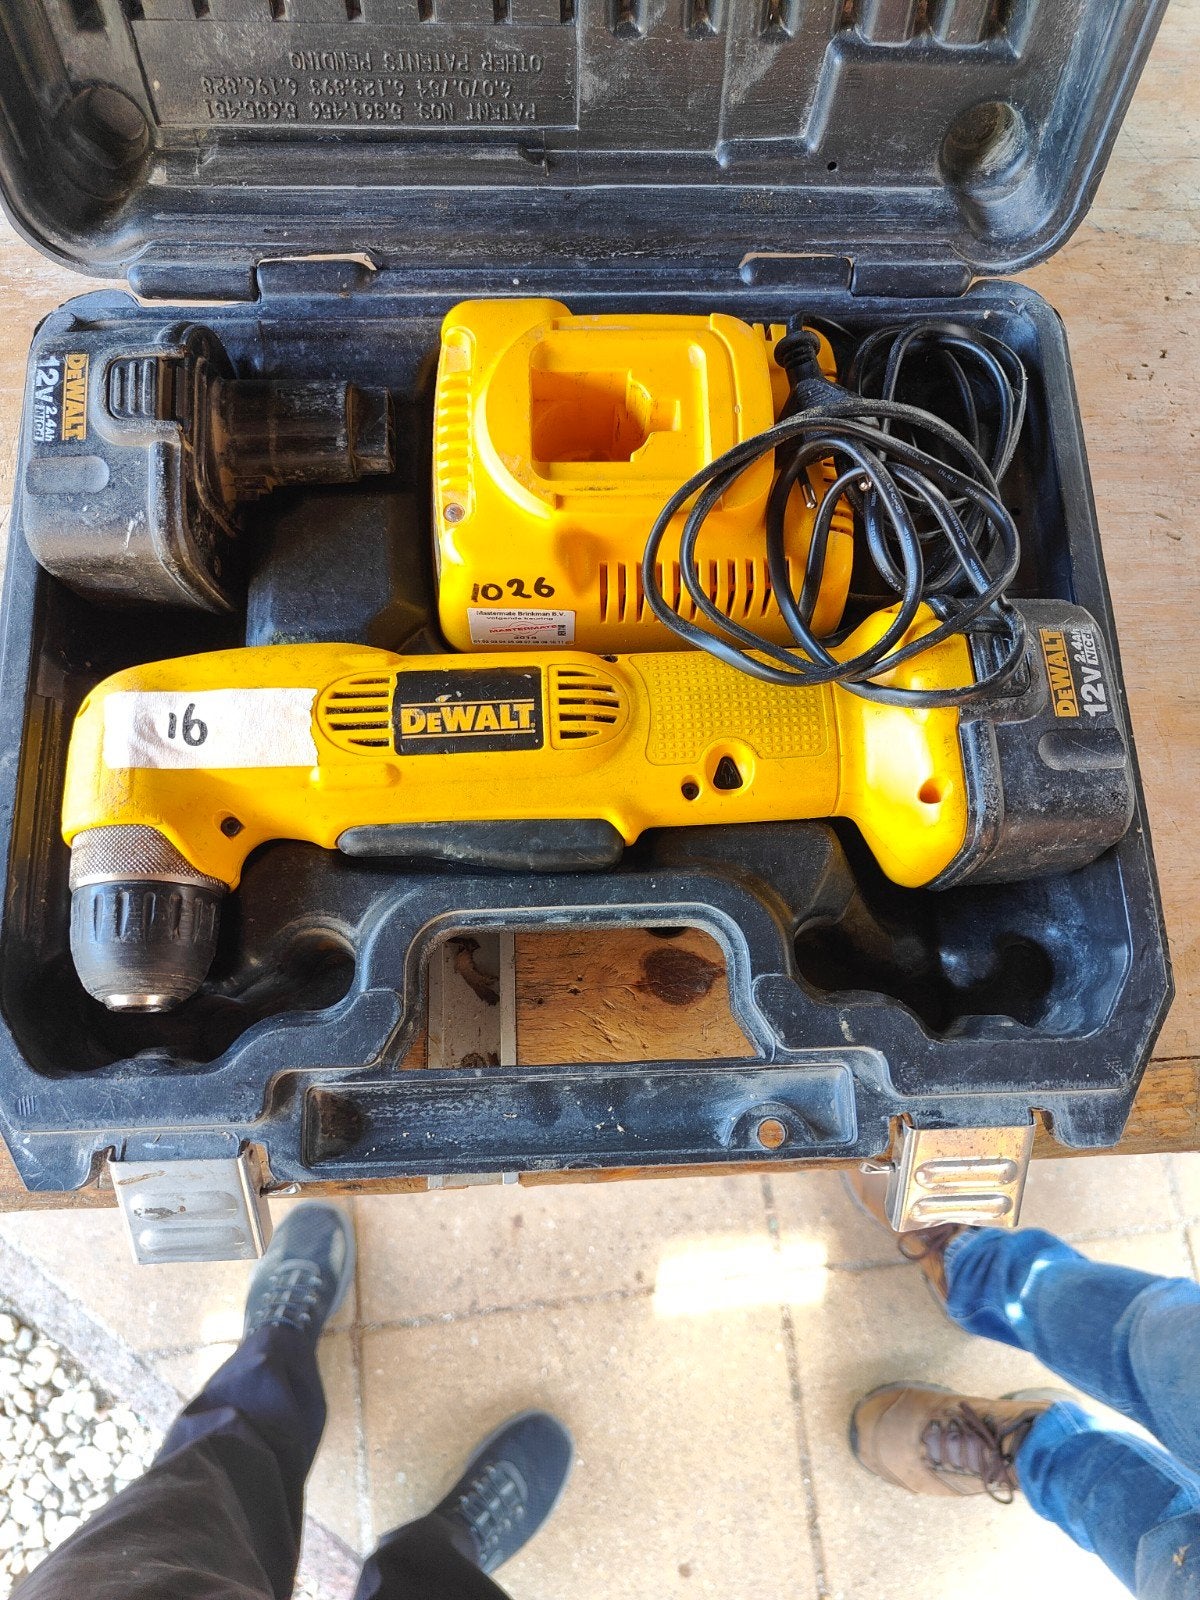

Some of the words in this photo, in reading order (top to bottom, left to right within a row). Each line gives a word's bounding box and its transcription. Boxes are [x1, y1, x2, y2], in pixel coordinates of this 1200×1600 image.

[289, 51, 373, 71] PENDING
[384, 52, 469, 72] PATENTS
[481, 52, 544, 72] OTHER
[466, 101, 536, 121] PATENT
[471, 577, 555, 602] 1026
[168, 703, 208, 746] 16
